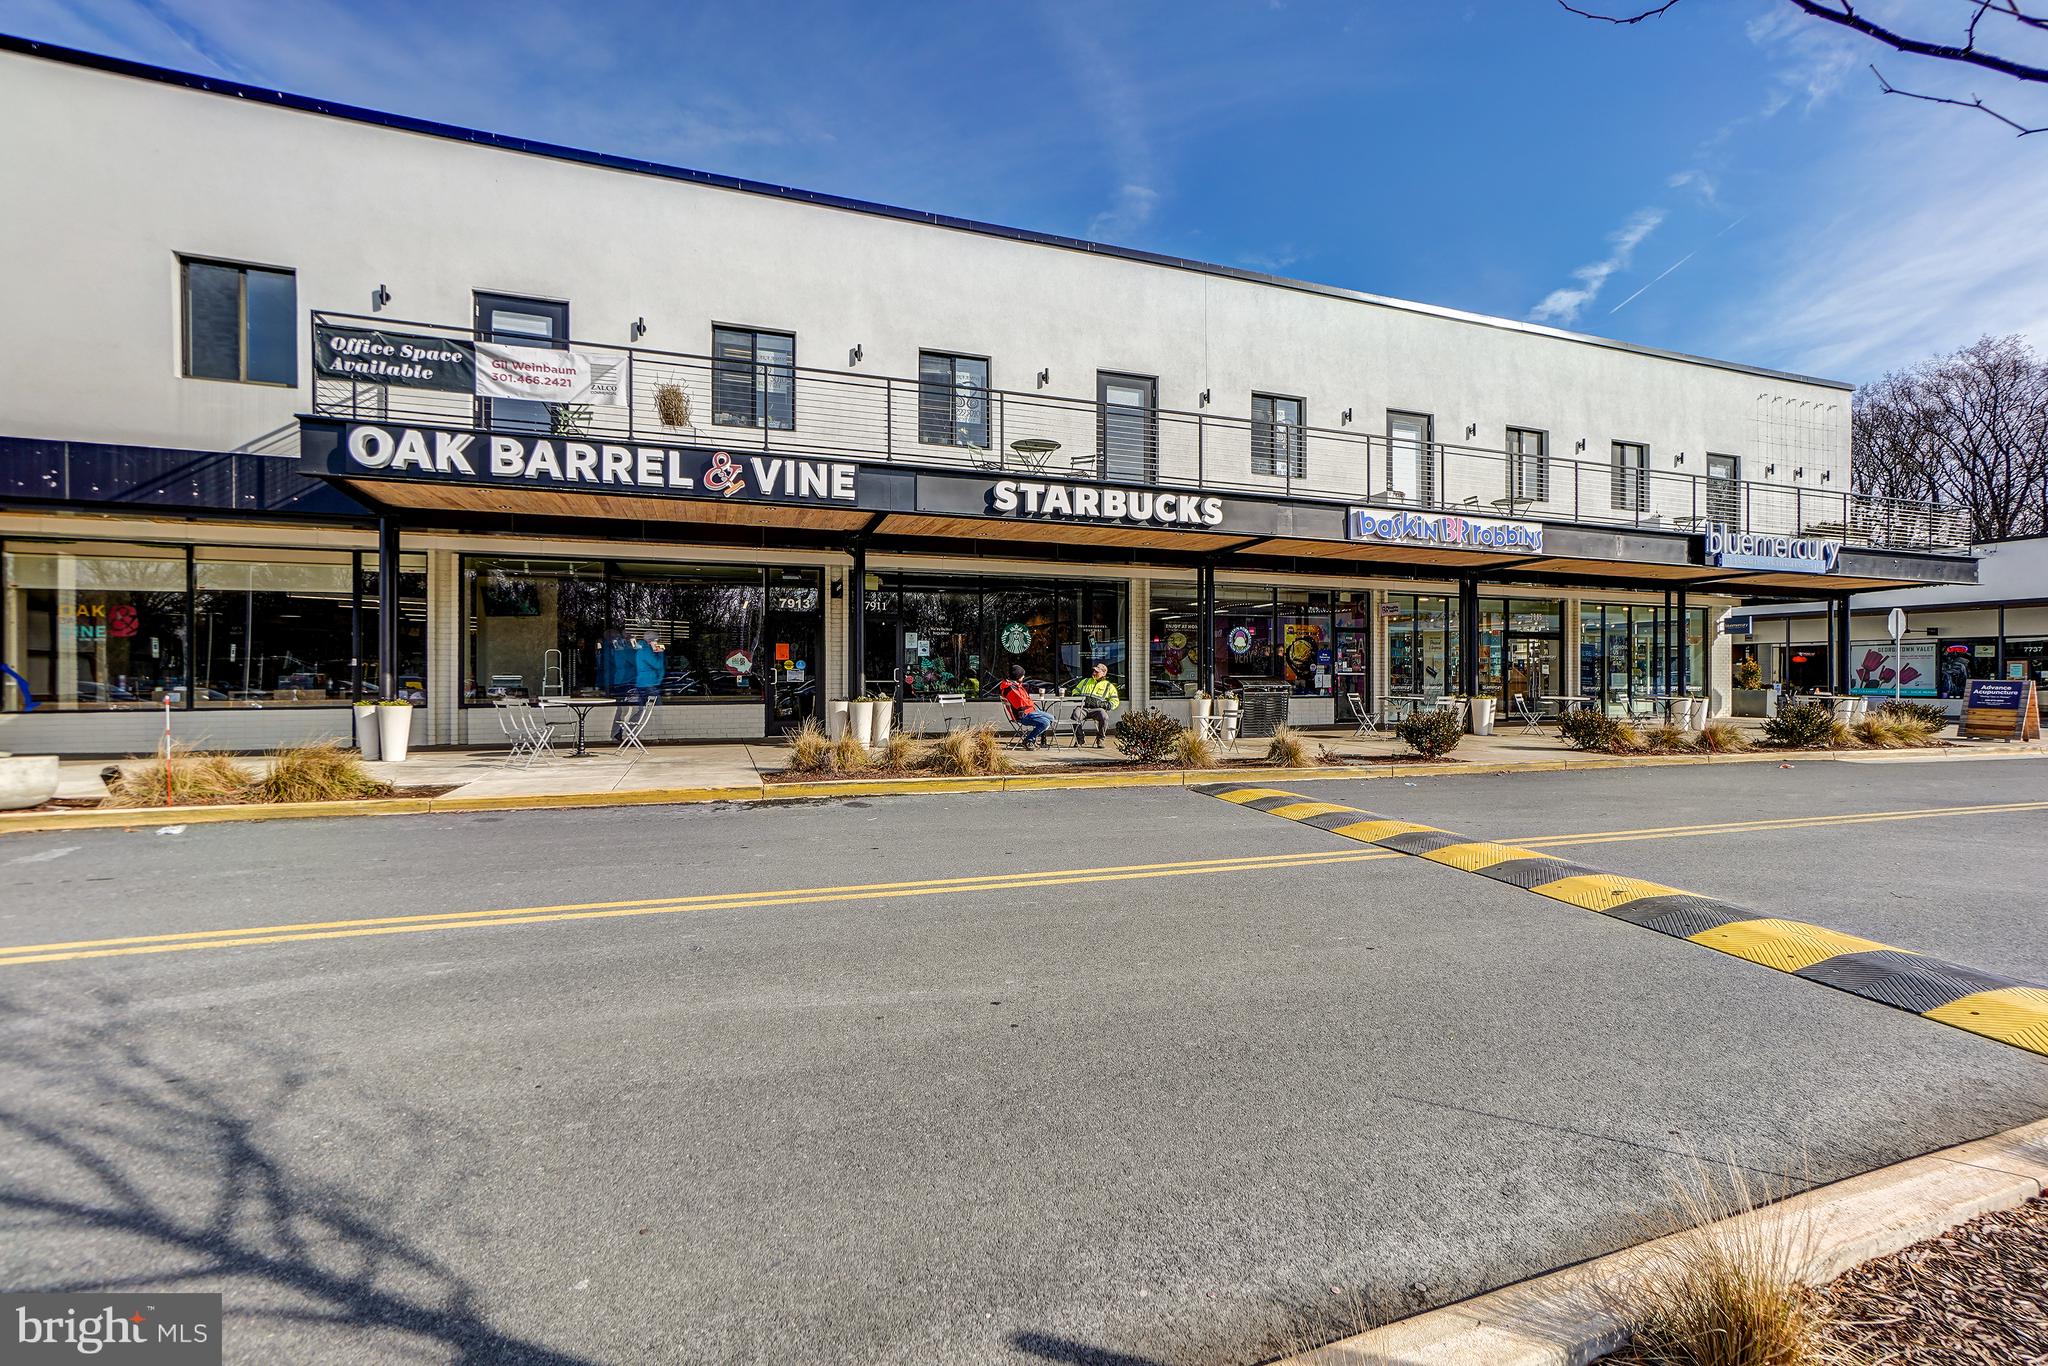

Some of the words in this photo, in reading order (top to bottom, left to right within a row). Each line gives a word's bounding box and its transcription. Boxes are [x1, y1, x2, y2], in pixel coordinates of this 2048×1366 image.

[329, 336, 395, 358] Office
[399, 344, 463, 364] Space
[329, 359, 433, 381] Available
[491, 359, 508, 370] Gil
[511, 361, 577, 376] Weinbaum
[491, 372, 572, 388] 301.466.2421
[591, 384, 618, 392] ZALCO
[348, 426, 477, 475] OAK
[491, 436, 694, 490] BARREL
[703, 451, 747, 498] &
[751, 456, 857, 499] VINE
[993, 480, 1224, 526] STARBUCKS
[1359, 510, 1437, 542] baskin
[1472, 523, 1544, 550] robbins
[1707, 521, 1841, 571] bluemercury
[779, 598, 811, 609] 7913
[864, 600, 887, 611] 7911
